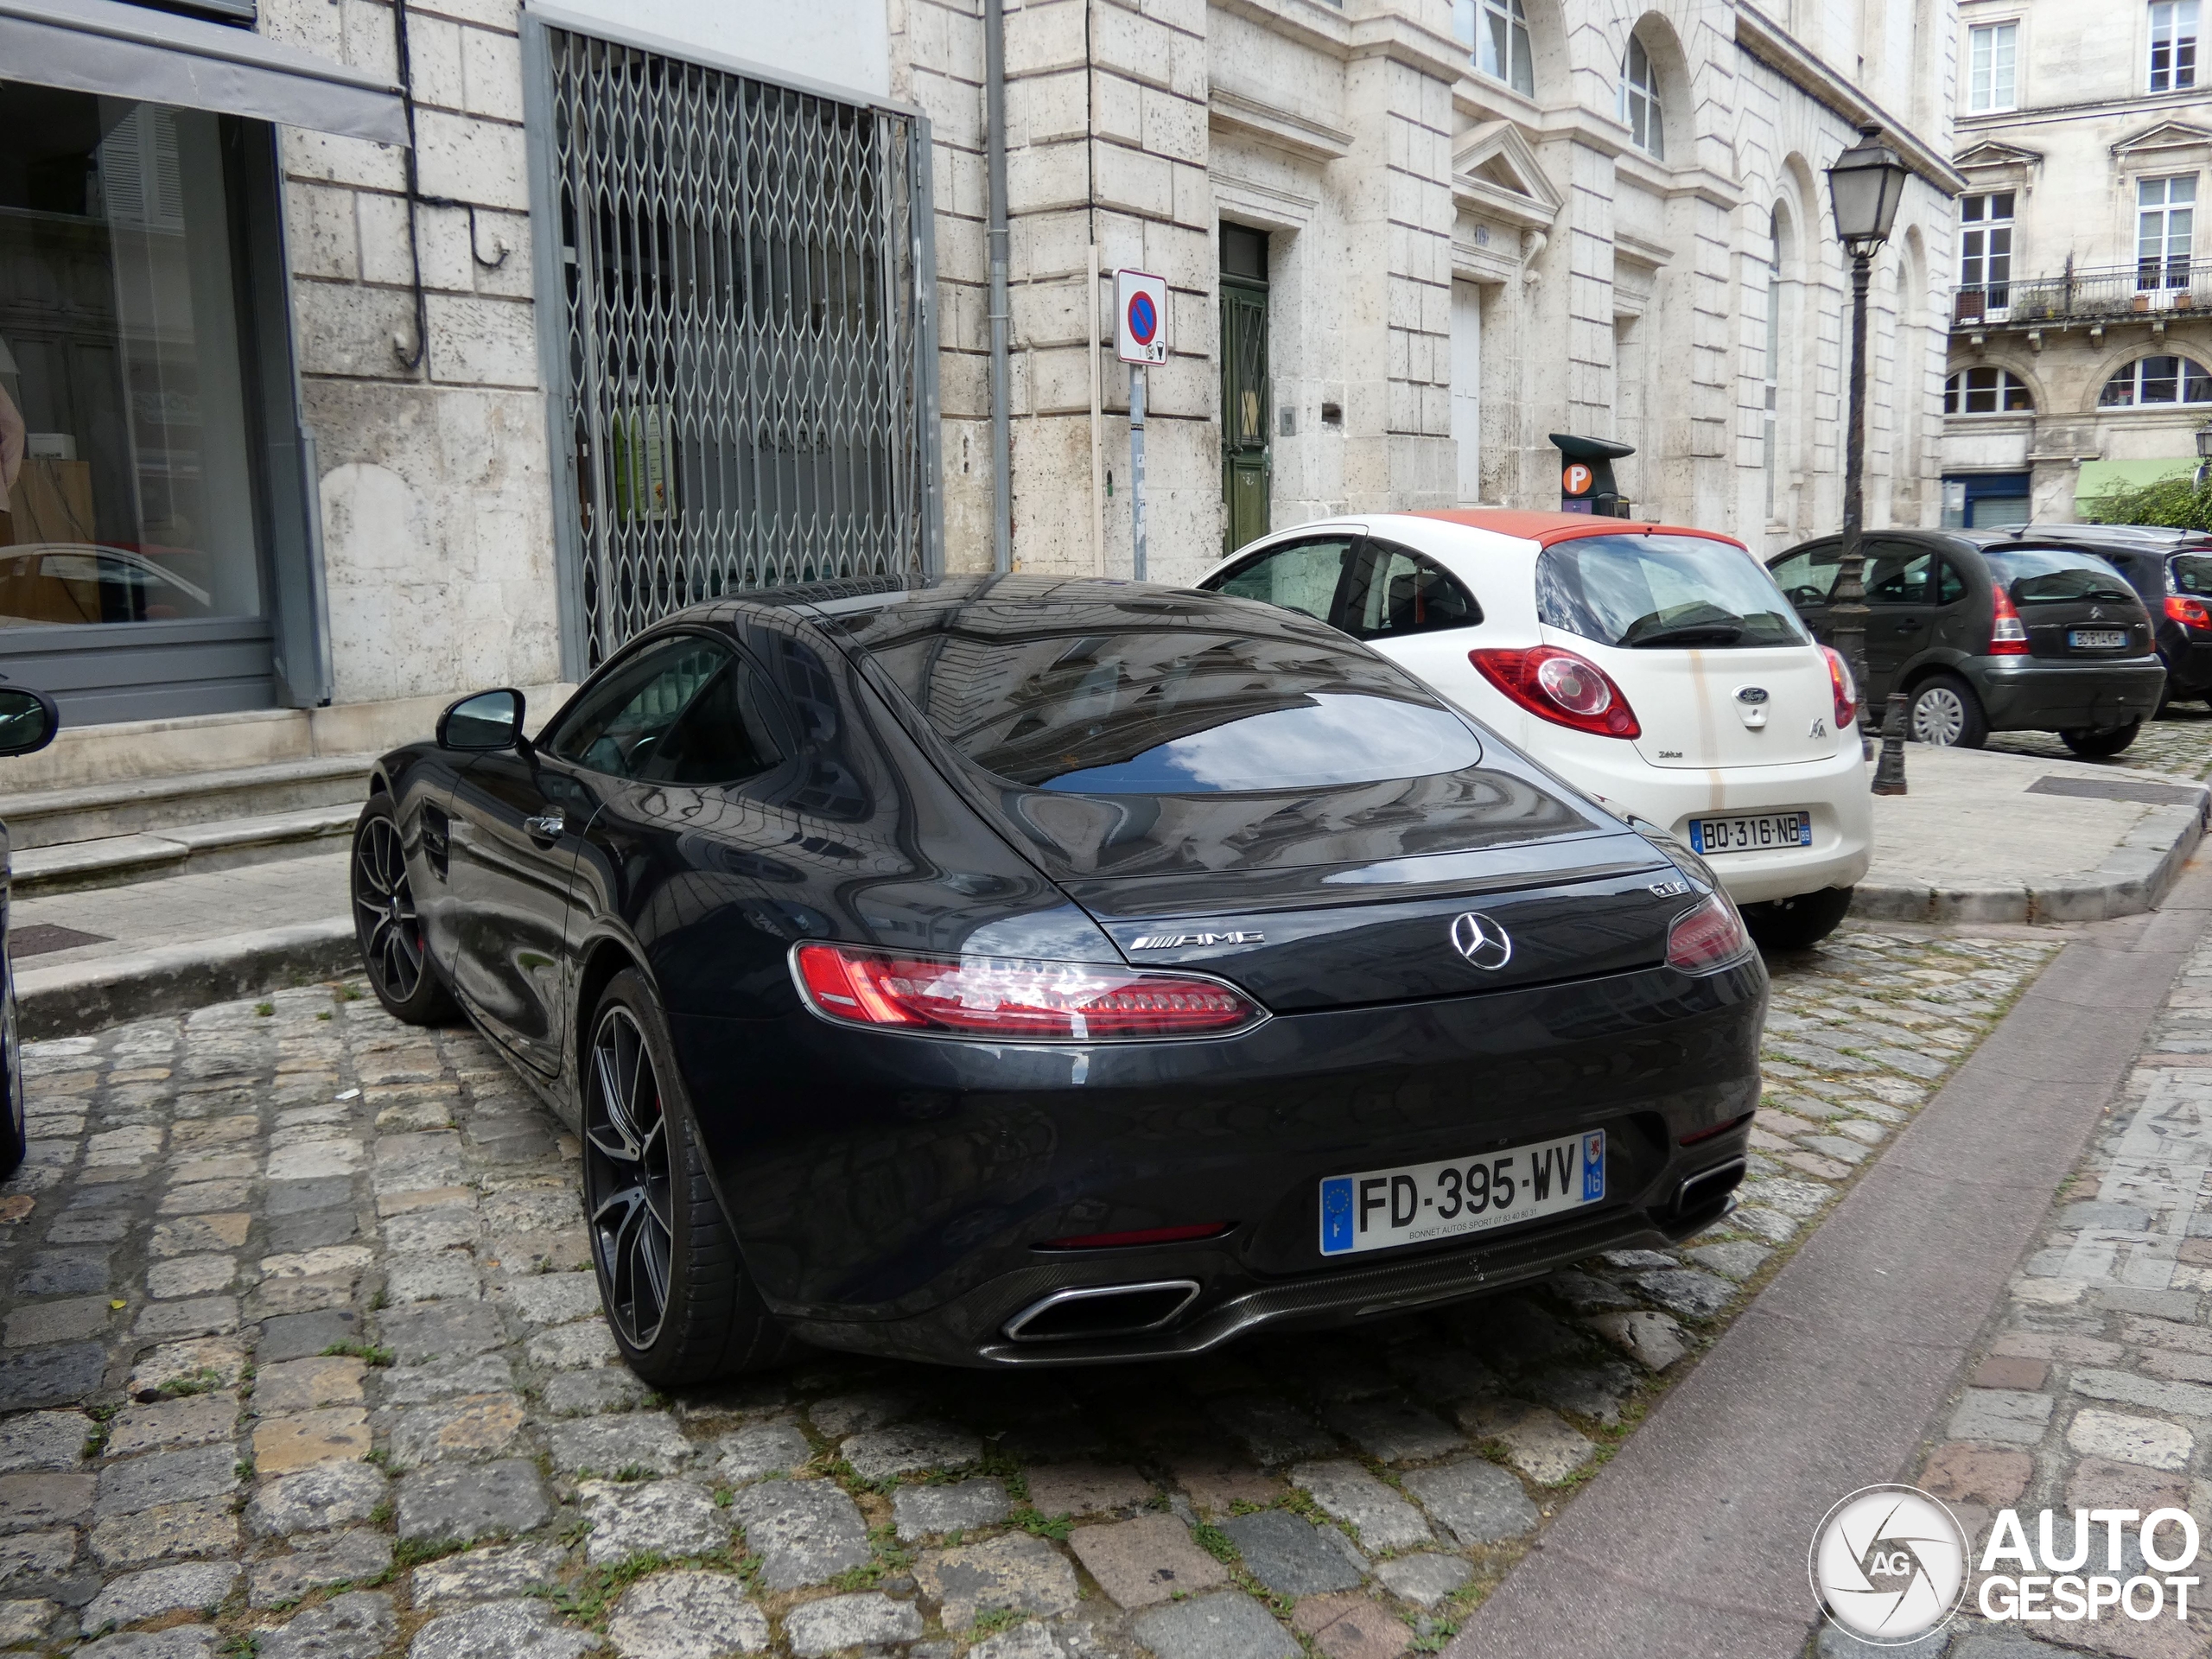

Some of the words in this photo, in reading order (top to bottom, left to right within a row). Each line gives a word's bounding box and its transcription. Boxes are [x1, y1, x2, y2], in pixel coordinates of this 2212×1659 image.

[1478, 228, 1486, 245] 19
[1571, 467, 1587, 492] P
[1173, 931, 1266, 948] AMG
[1359, 1143, 1576, 1233] FD-395-WV
[1586, 1171, 1601, 1194] 16
[1409, 1227, 1441, 1240] BONNET
[1442, 1223, 1467, 1234] AUTOS
[1469, 1217, 1492, 1230] SPORT
[1494, 1216, 1502, 1224] 07
